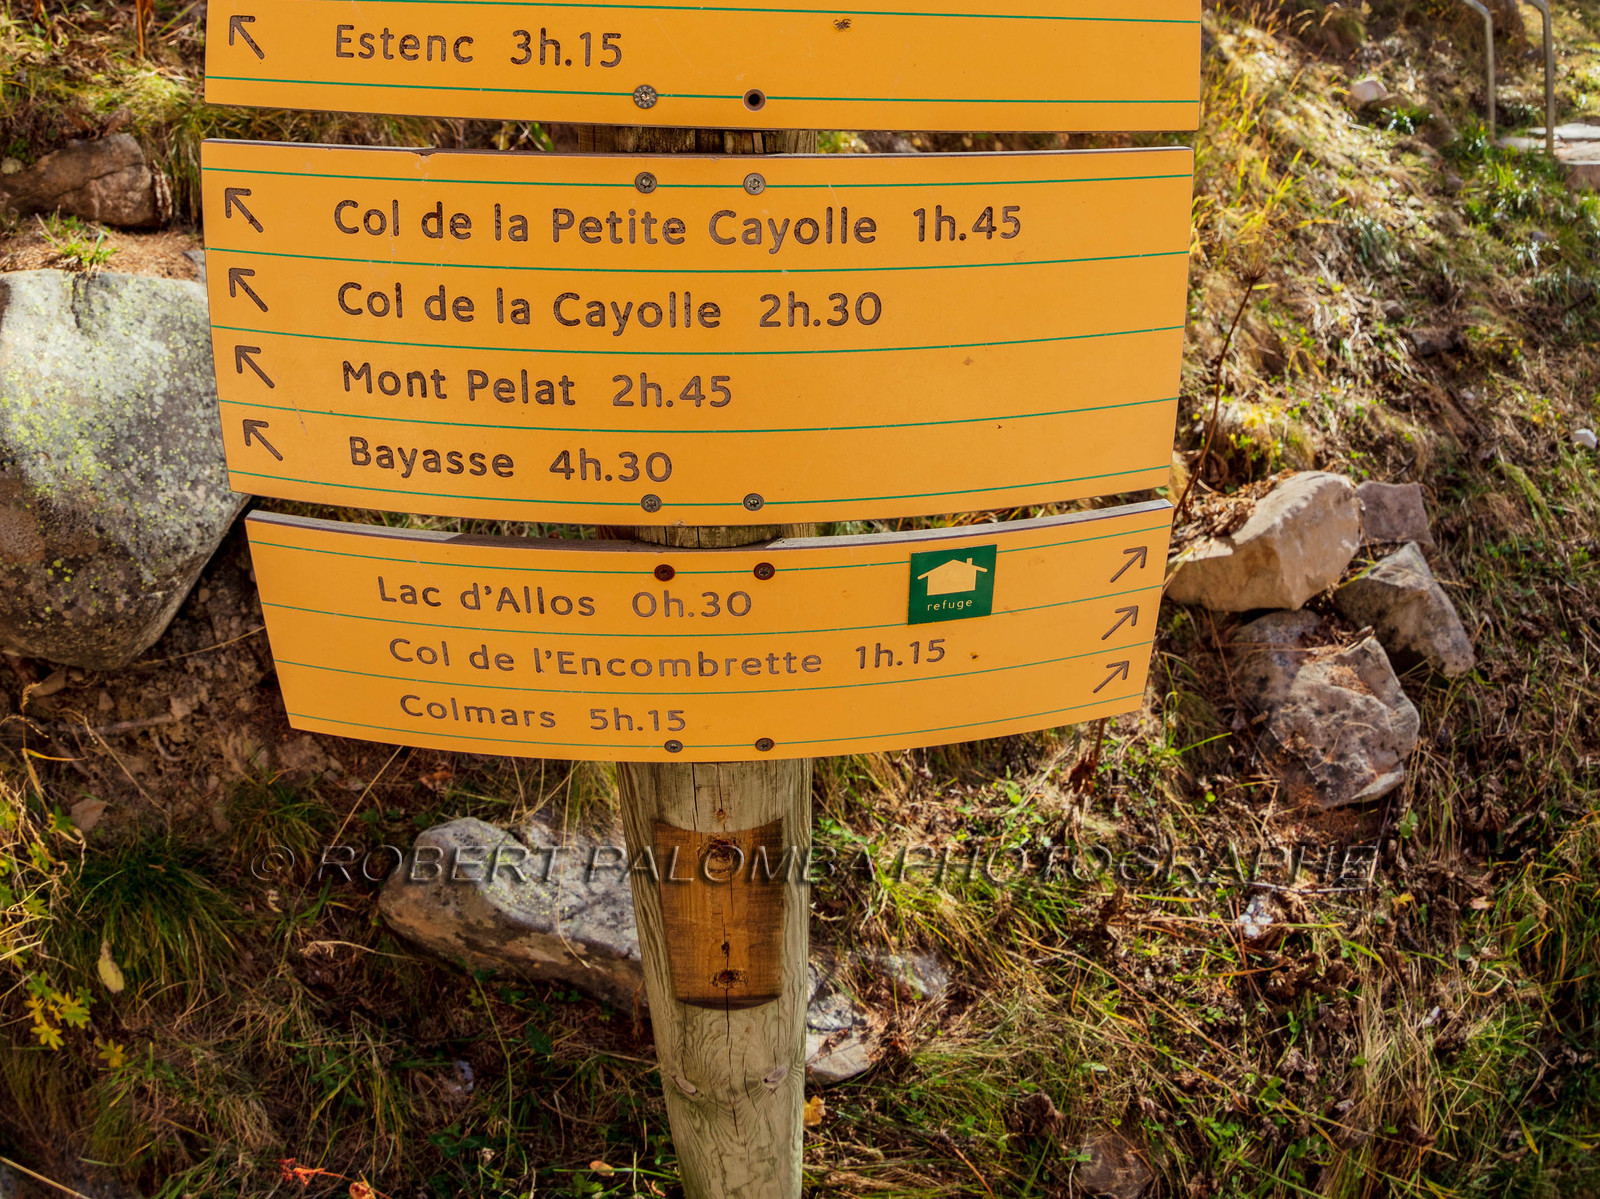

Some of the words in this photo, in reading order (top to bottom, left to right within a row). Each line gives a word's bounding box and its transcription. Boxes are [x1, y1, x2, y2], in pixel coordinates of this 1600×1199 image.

[335, 24, 474, 64] Estenc
[509, 27, 623, 68] 3h.15
[333, 198, 400, 237] Col
[420, 200, 473, 241] de
[493, 202, 529, 243] la
[552, 207, 687, 246] Petite
[708, 206, 877, 255] Cayolle
[912, 204, 1021, 243] 1h.45
[337, 281, 403, 319] Col
[423, 284, 475, 323] de
[496, 286, 531, 326] la
[552, 290, 722, 337] Cayolle
[759, 290, 882, 328] 2h.30
[342, 360, 448, 400] Mont
[467, 368, 576, 407] Pelat
[611, 371, 732, 408] 2h.45
[348, 435, 515, 479] Bayasse
[548, 447, 673, 483] 4h.30
[377, 575, 442, 608] Lac
[459, 582, 596, 617] d'Allos
[631, 589, 752, 618] 0h.30
[926, 599, 973, 612] refuge
[389, 637, 450, 667] Col
[468, 643, 515, 673] de
[533, 647, 822, 677] l'Encombrette
[855, 638, 946, 670] 1h.15
[399, 694, 556, 729] Colmars
[589, 706, 686, 732] 5h.15
